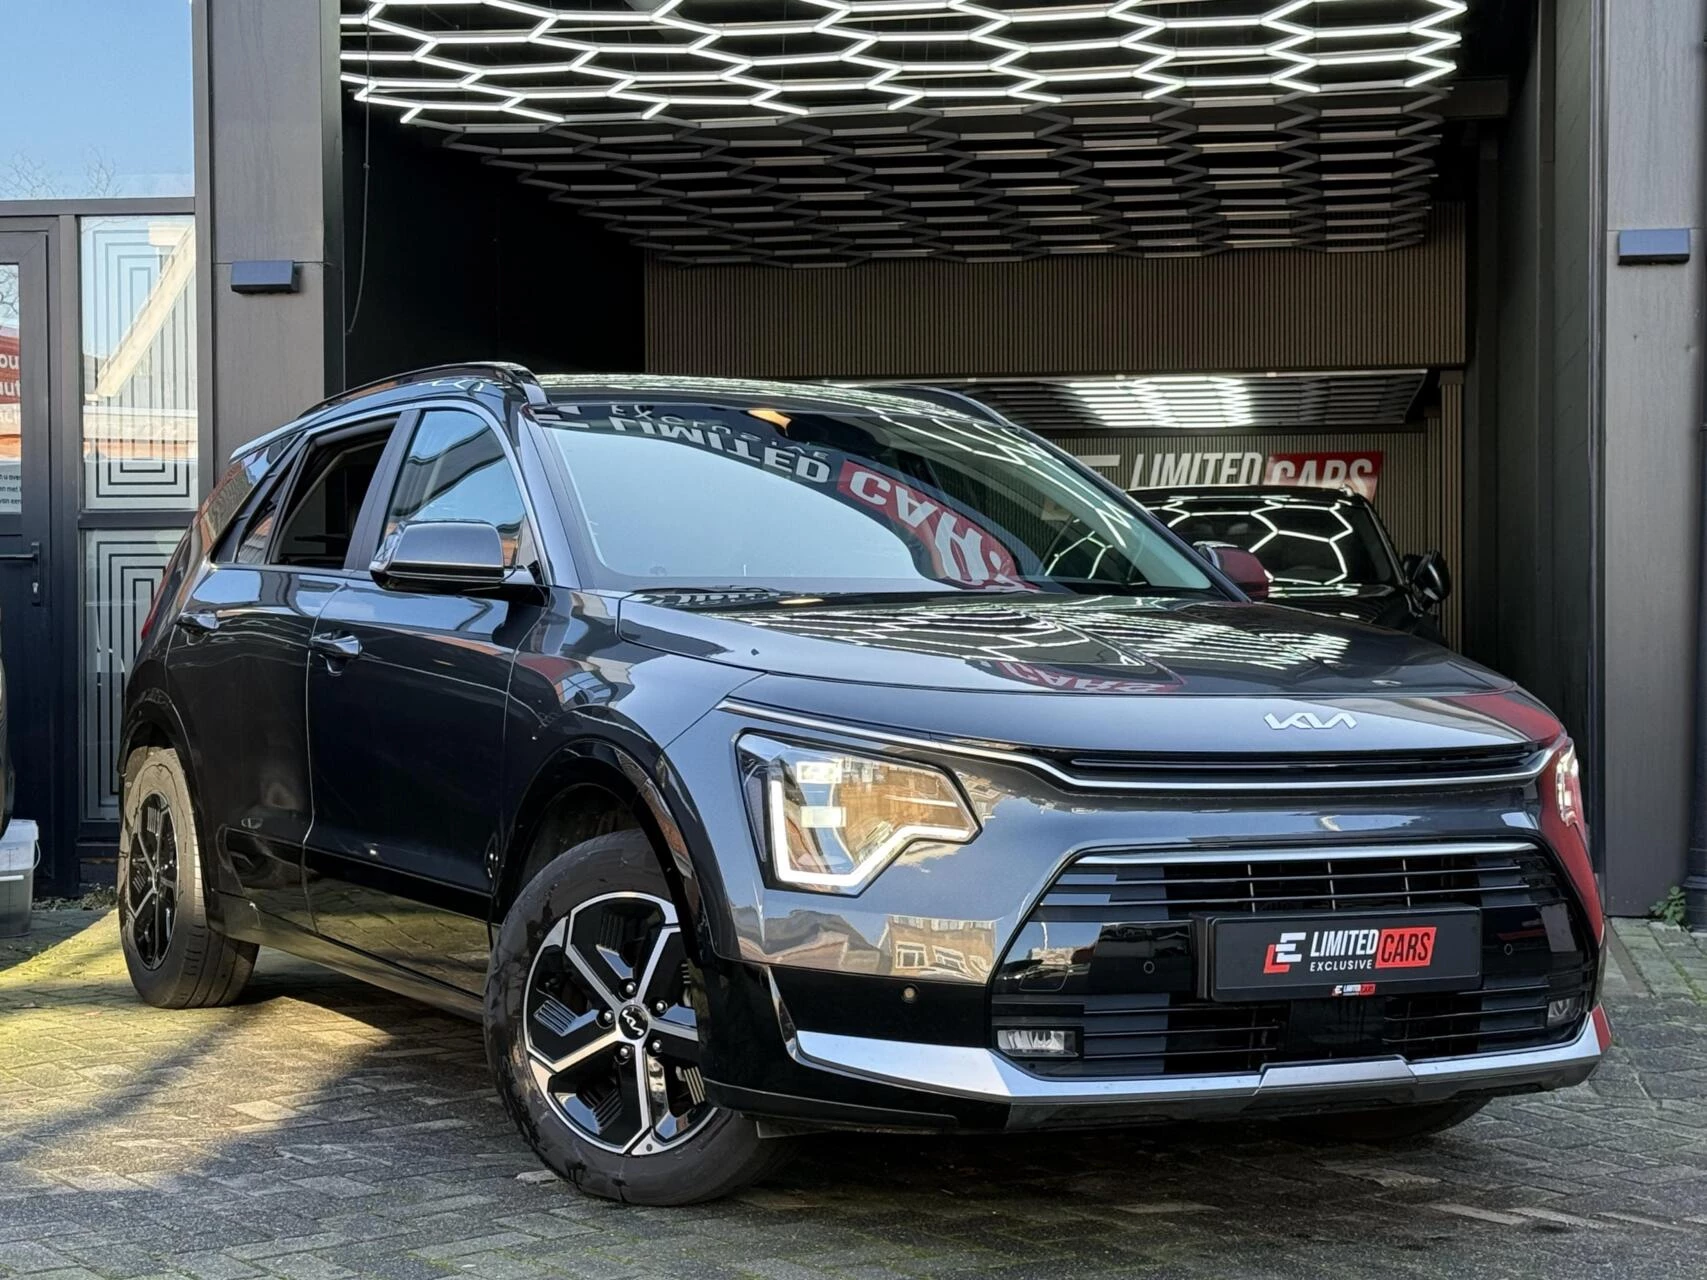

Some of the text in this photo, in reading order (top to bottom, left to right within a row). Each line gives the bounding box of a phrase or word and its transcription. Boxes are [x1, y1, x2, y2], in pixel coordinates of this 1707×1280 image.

[1310, 929, 1380, 957] LIMITED
[1381, 932, 1431, 963] CARS
[1310, 959, 1373, 972] EXCLUSIVE
